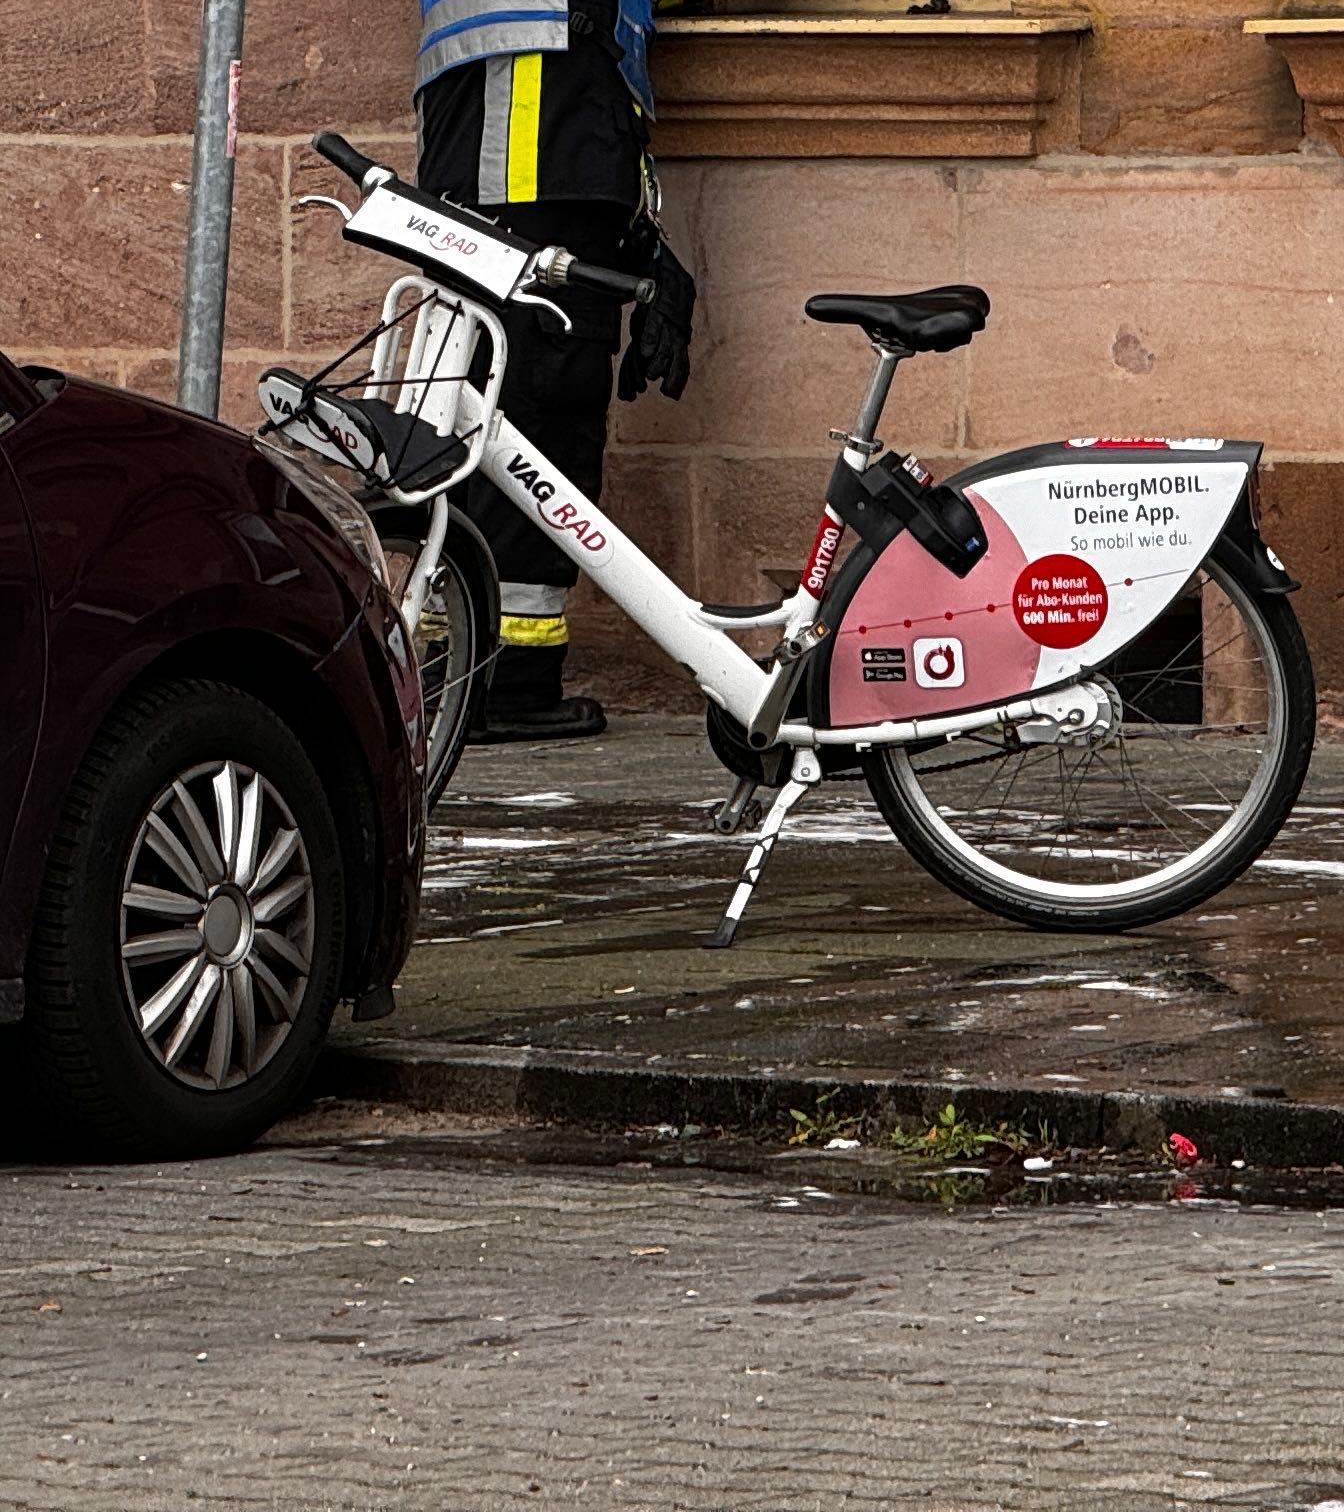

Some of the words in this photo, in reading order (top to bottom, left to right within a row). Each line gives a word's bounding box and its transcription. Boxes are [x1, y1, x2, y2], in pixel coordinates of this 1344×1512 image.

[406, 210, 440, 238] VAG
[440, 231, 479, 256] RAD
[1048, 475, 1210, 502] NürnbergMOBIL.
[506, 452, 556, 504] VAG
[552, 502, 607, 552] RAD
[1074, 504, 1129, 525] Deine
[1135, 504, 1180, 527] App.
[1070, 535, 1088, 552] So
[1093, 532, 1134, 551] mobil
[1138, 531, 1165, 548] wie
[1169, 530, 1193, 547] du.
[807, 527, 841, 590] 901780
[1031, 577, 1050, 591] Pro
[1052, 576, 1088, 590] Monat
[1017, 593, 1034, 608] für
[1036, 591, 1103, 607] Abo-Kunden
[1023, 610, 1045, 625] 600
[1047, 609, 1075, 625] Min.
